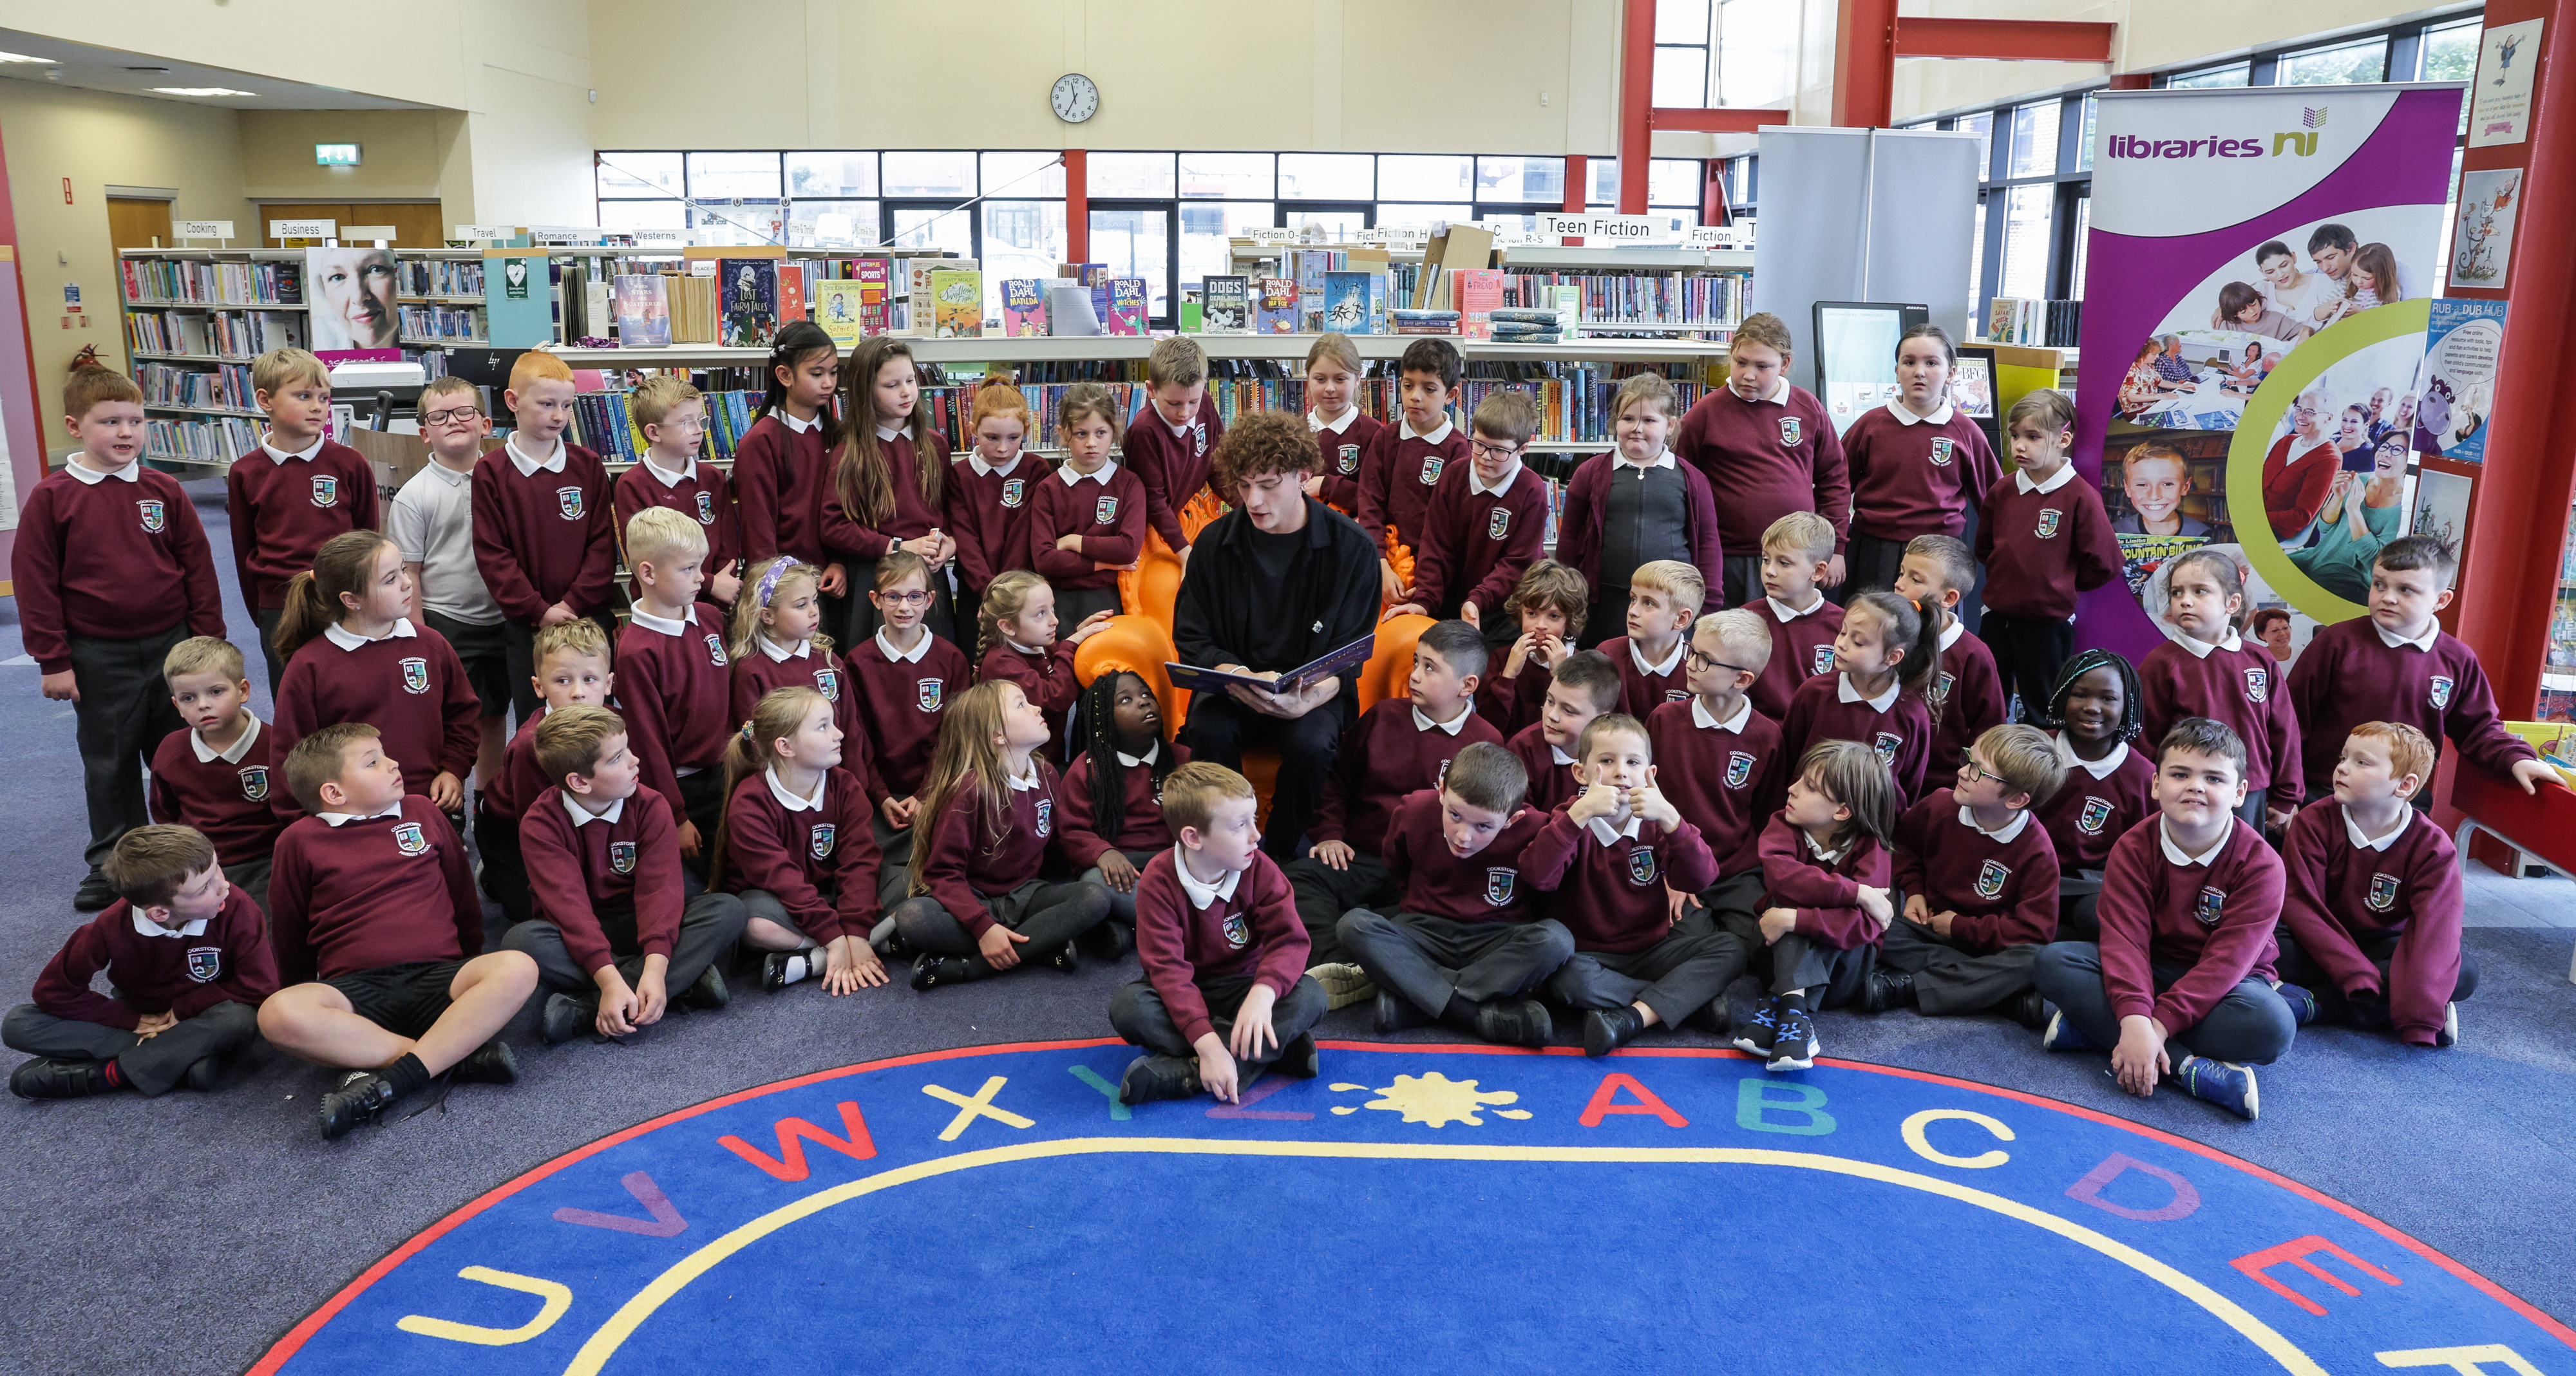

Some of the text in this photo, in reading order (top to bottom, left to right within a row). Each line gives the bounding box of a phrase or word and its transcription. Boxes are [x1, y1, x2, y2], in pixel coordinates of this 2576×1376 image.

[2108, 131, 2318, 158] libraries ni
[186, 223, 217, 236] Cooking
[282, 223, 319, 234] Business
[790, 223, 800, 232] Crime
[1547, 218, 1649, 236] Teen Fiction
[473, 228, 497, 238] Travel
[538, 232, 578, 240] Romance
[1253, 230, 1285, 239] Fiction
[1378, 228, 1414, 238] Fiction
[1692, 230, 1731, 241] Fiction
[861, 270, 881, 279] SPORTS
[1008, 279, 1035, 288] ROALD
[1114, 279, 1141, 288] ROALD
[1209, 281, 1242, 294] DOGS
[1265, 280, 1293, 288] ROALD
[1473, 282, 1493, 290] FRIEND
[741, 290, 755, 301] LOST
[1010, 287, 1037, 297] DAHL
[1115, 287, 1141, 297] DAHL
[1265, 287, 1292, 297] DAHL
[751, 301, 768, 312] TALES
[1010, 297, 1039, 306] MATILDA
[2484, 305, 2504, 317] HUB
[1522, 323, 1543, 332] ICKABOG
[1962, 367, 1985, 380] BFG
[1779, 438, 1803, 447] PRIMARY SCHOOL
[556, 485, 582, 494] COOKSTOWN
[310, 498, 325, 508] PRIMARY
[574, 511, 586, 520] SCHOOL
[1491, 507, 1511, 515] COOKSTOWN
[402, 684, 431, 694] PRIMARY SCHOOL
[916, 704, 943, 713] PRIMARY SCHOOL
[1877, 732, 1903, 743] COOKSTOWN
[1729, 750, 1757, 761] COOKSTOWN
[238, 765, 269, 775] COOKSTOWN
[1723, 777, 1734, 788] PRIMARY
[2085, 795, 2115, 809] COOKSTOWN
[391, 822, 421, 832] COOKSTOWN
[2075, 820, 2088, 834] PRIMARY
[419, 844, 431, 854] SCHOOL
[1983, 859, 2012, 874] COOKSTOWN
[1630, 878, 1647, 887] PRIMARY
[2372, 872, 2401, 883] COOKSTOWN
[1973, 883, 1985, 898] PRIMARY
[1482, 894, 1514, 907] PRIMARY SCHOOL
[1578, 1073, 1690, 1128] A
[1736, 1078, 1837, 1136] B
[1901, 1109, 2016, 1169] C
[2065, 1152, 2201, 1221] D
[2228, 1235, 2403, 1316] E
[397, 1265, 573, 1346] U
[552, 1170, 688, 1238] V
[716, 1100, 878, 1182] W
[922, 1076, 1036, 1141] X
